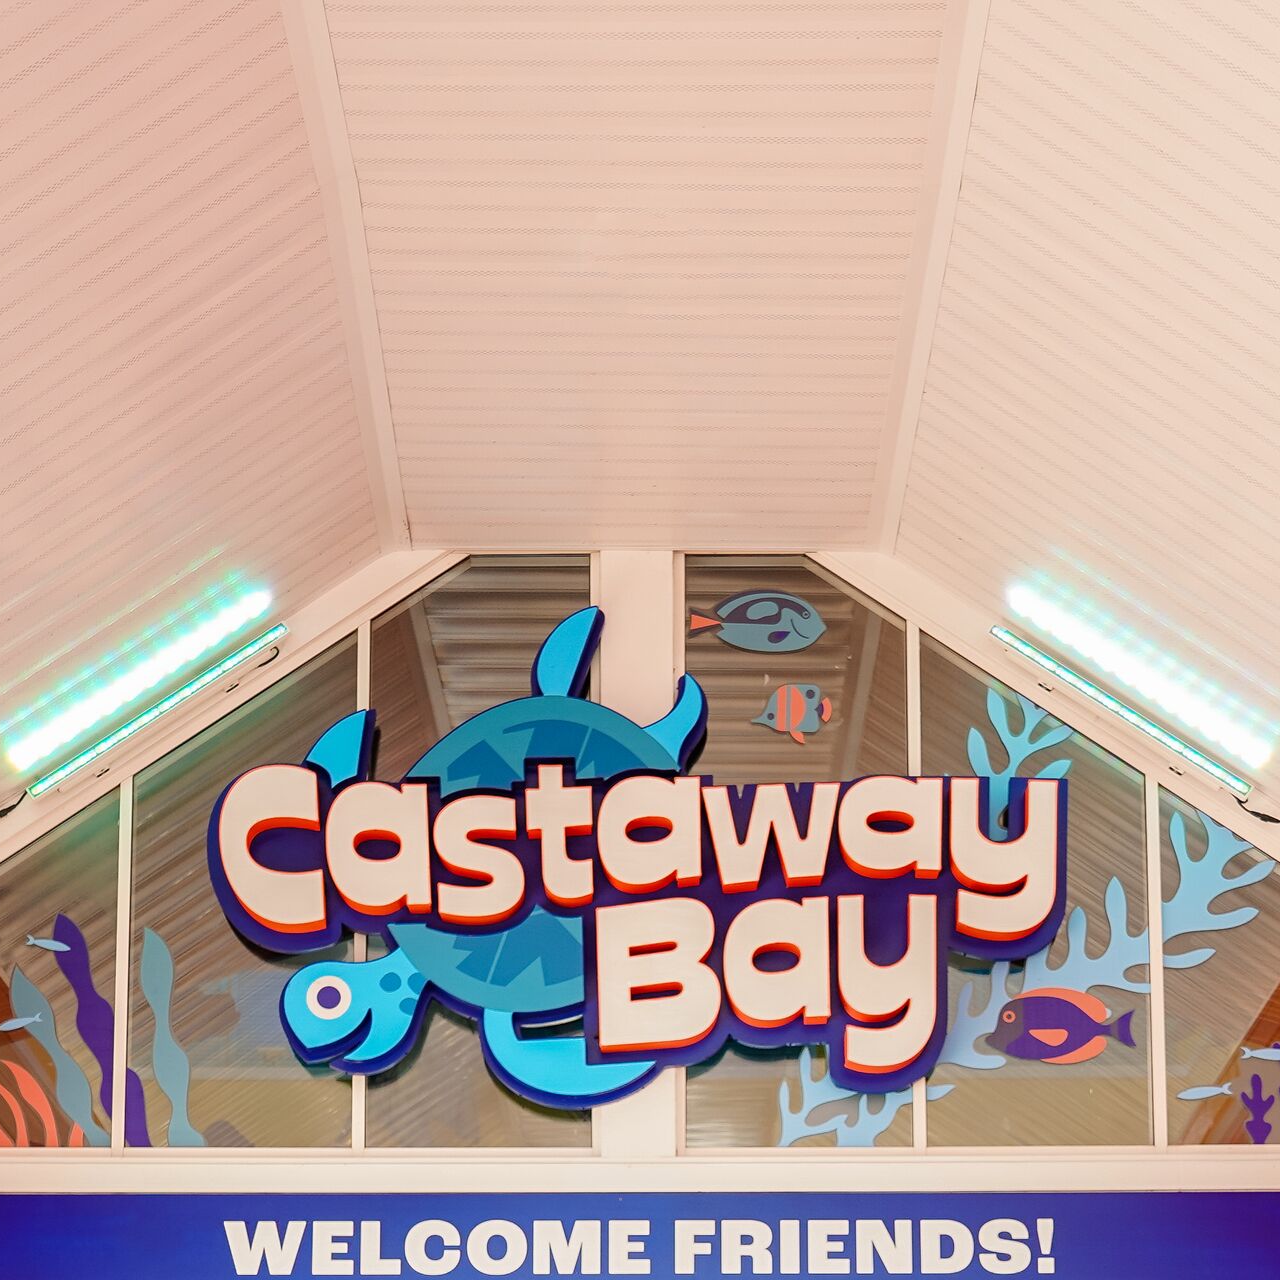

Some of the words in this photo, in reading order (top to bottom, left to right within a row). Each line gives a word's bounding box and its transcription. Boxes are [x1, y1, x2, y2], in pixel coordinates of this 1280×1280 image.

[218, 763, 1059, 942] Castaway
[596, 893, 938, 1074] Bay
[223, 1219, 651, 1277] WELCOME
[674, 1218, 1057, 1275] FRIENDS!
